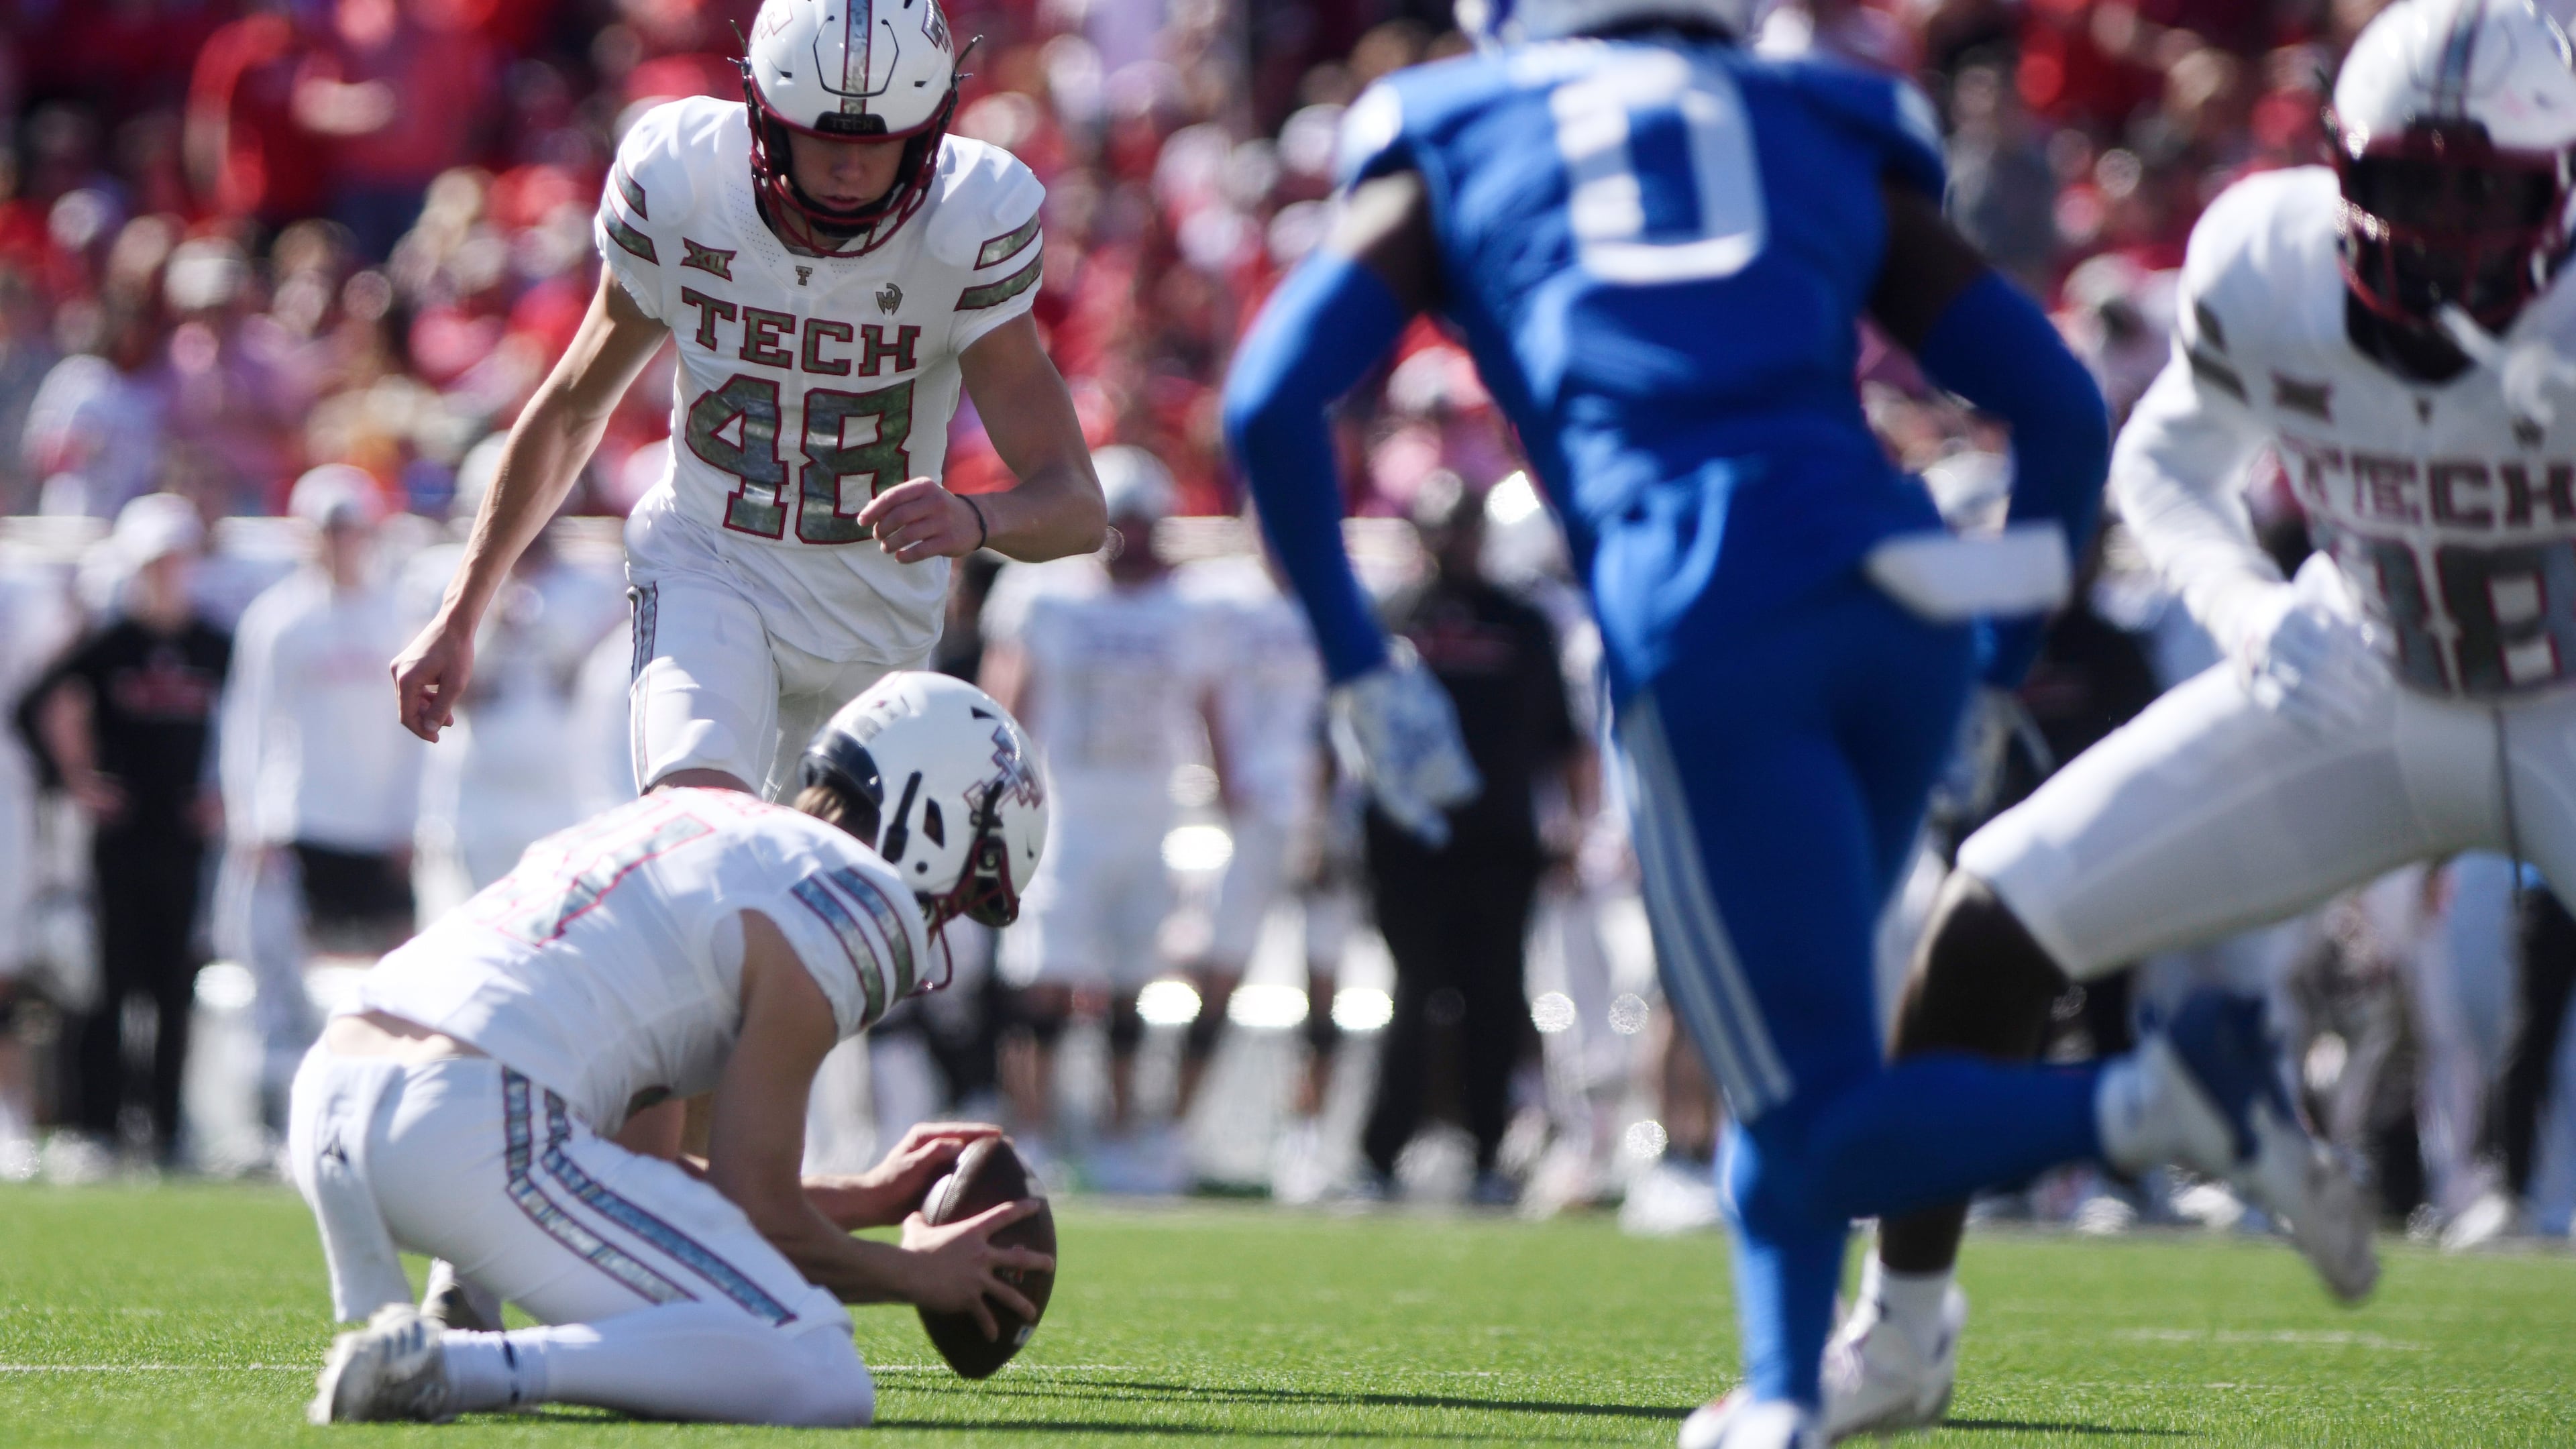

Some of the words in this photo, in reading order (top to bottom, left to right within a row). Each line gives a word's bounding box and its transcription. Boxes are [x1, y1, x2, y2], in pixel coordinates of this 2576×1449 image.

[830, 116, 874, 131] TECH
[1552, 46, 1766, 284] 0
[681, 285, 921, 376] TECH
[685, 373, 915, 544] 48
[2281, 428, 2575, 527] TECH
